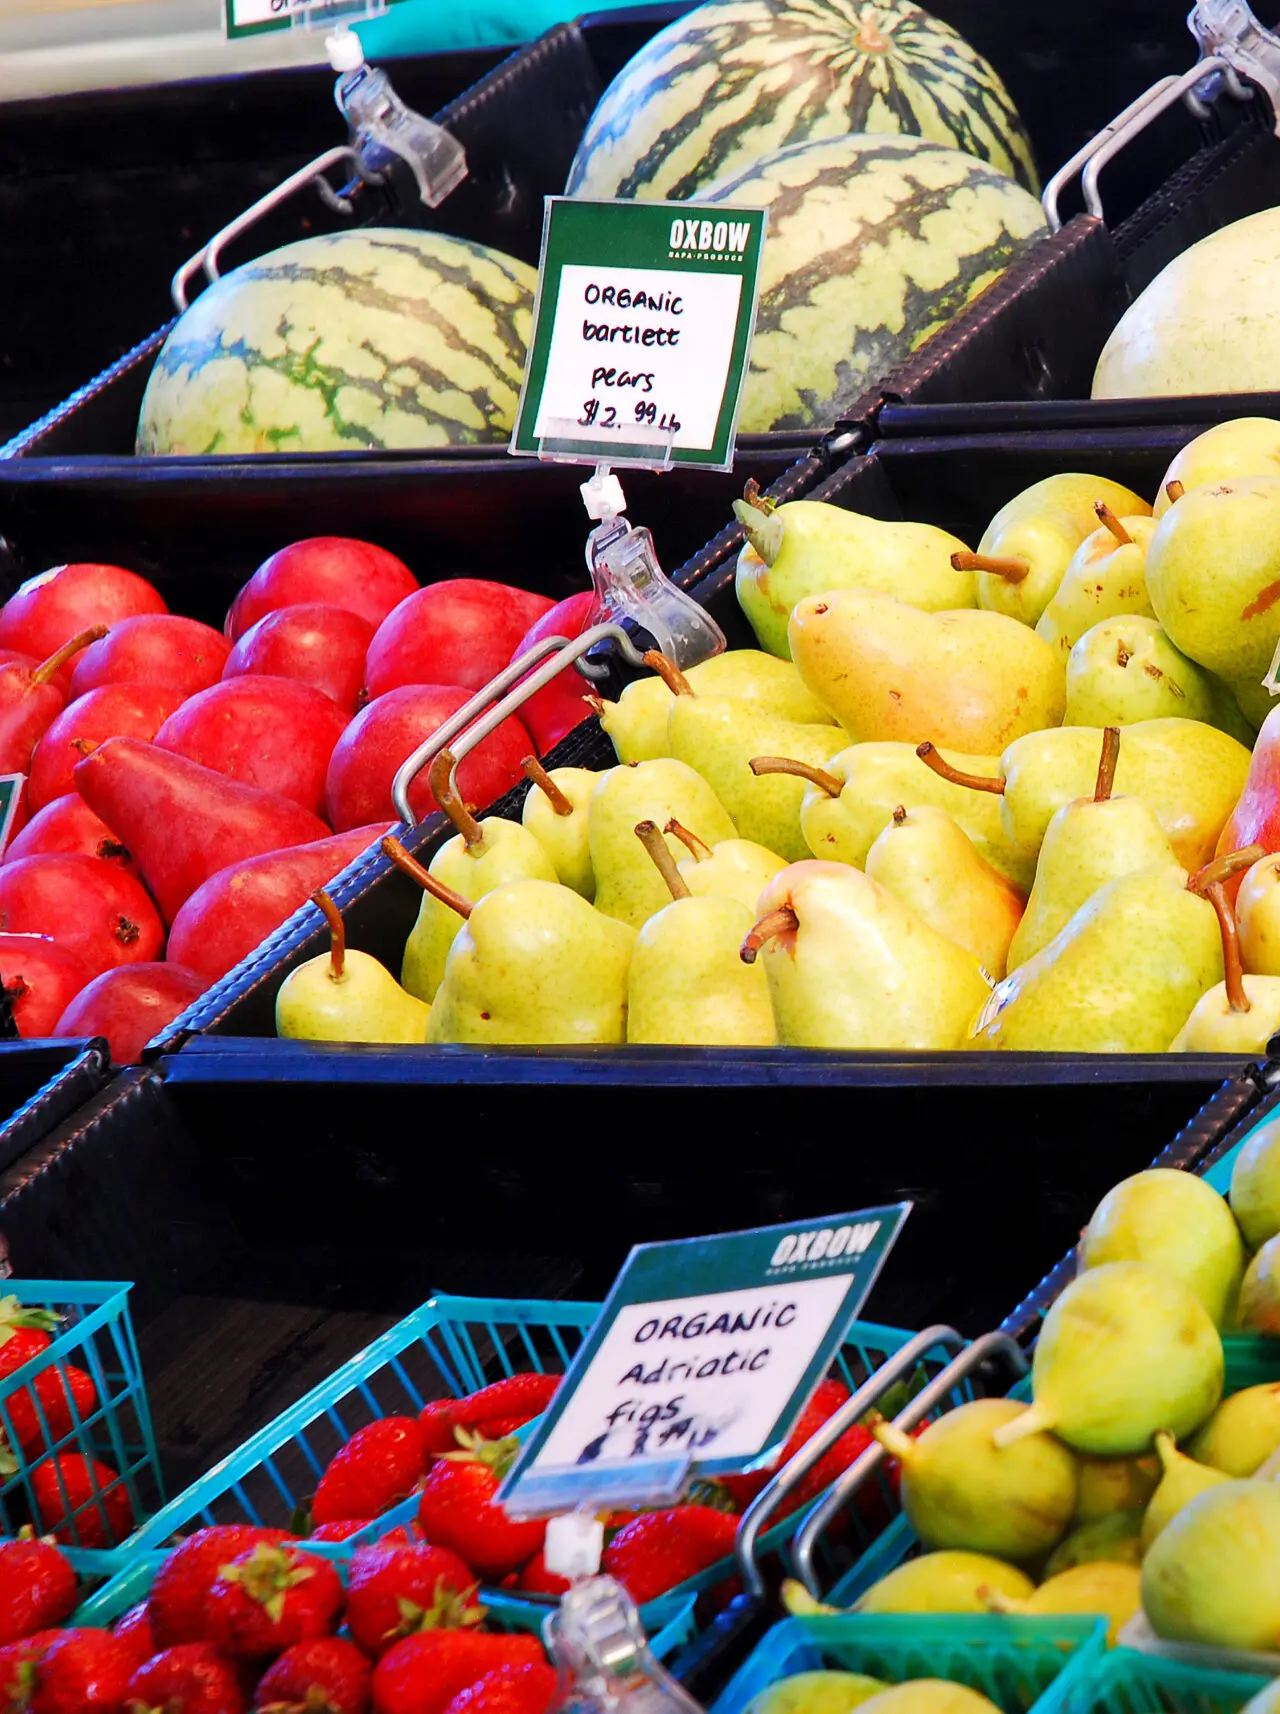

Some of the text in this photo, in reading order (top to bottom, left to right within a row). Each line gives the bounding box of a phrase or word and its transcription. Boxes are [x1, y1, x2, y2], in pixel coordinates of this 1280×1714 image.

[669, 219, 751, 252] OXBOW
[582, 319, 680, 346] bartlett
[769, 1220, 882, 1267] OXBOW
[619, 1348, 771, 1386] Adriatic
[606, 1395, 685, 1430] figs
